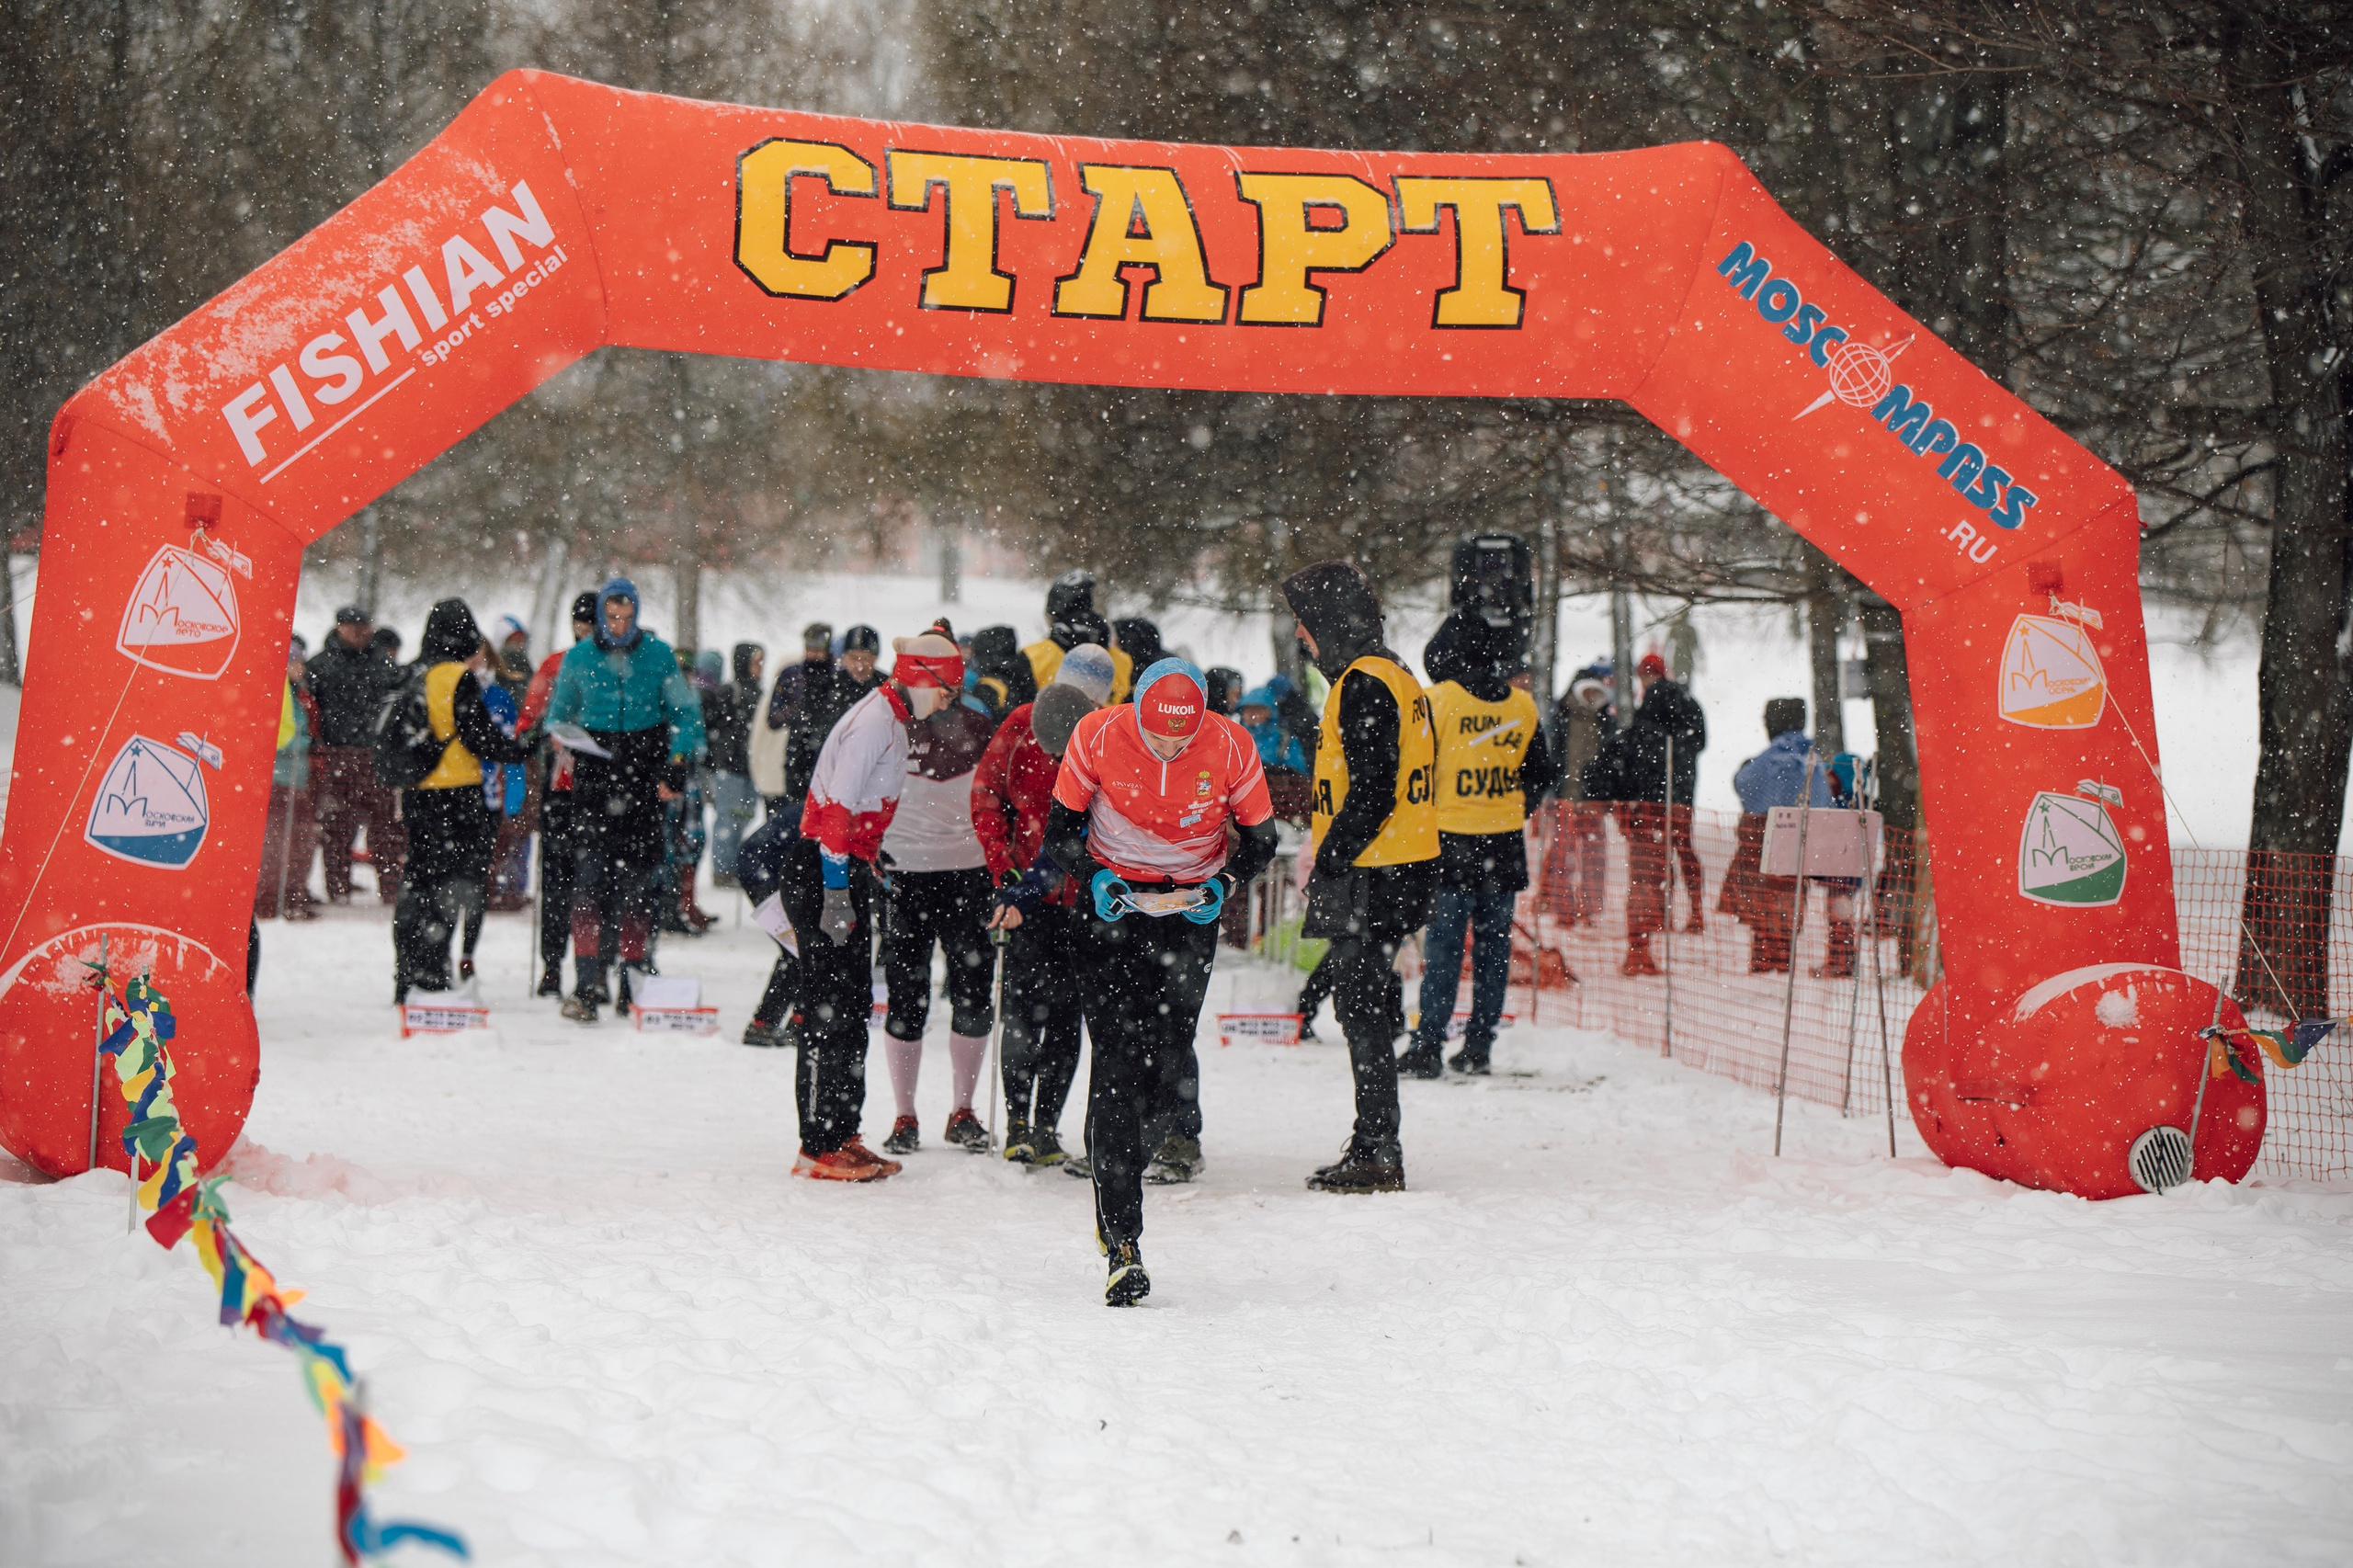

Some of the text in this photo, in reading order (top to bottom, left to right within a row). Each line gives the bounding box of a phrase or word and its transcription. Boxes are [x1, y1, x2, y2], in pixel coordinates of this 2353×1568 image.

[734, 137, 1562, 330] СТАРТ
[222, 179, 556, 468] FISHIAN
[421, 245, 569, 368] sport special
[1940, 519, 1998, 564] .RU
[1158, 702, 1196, 715] LUKOIL
[1460, 715, 1502, 734] RUN
